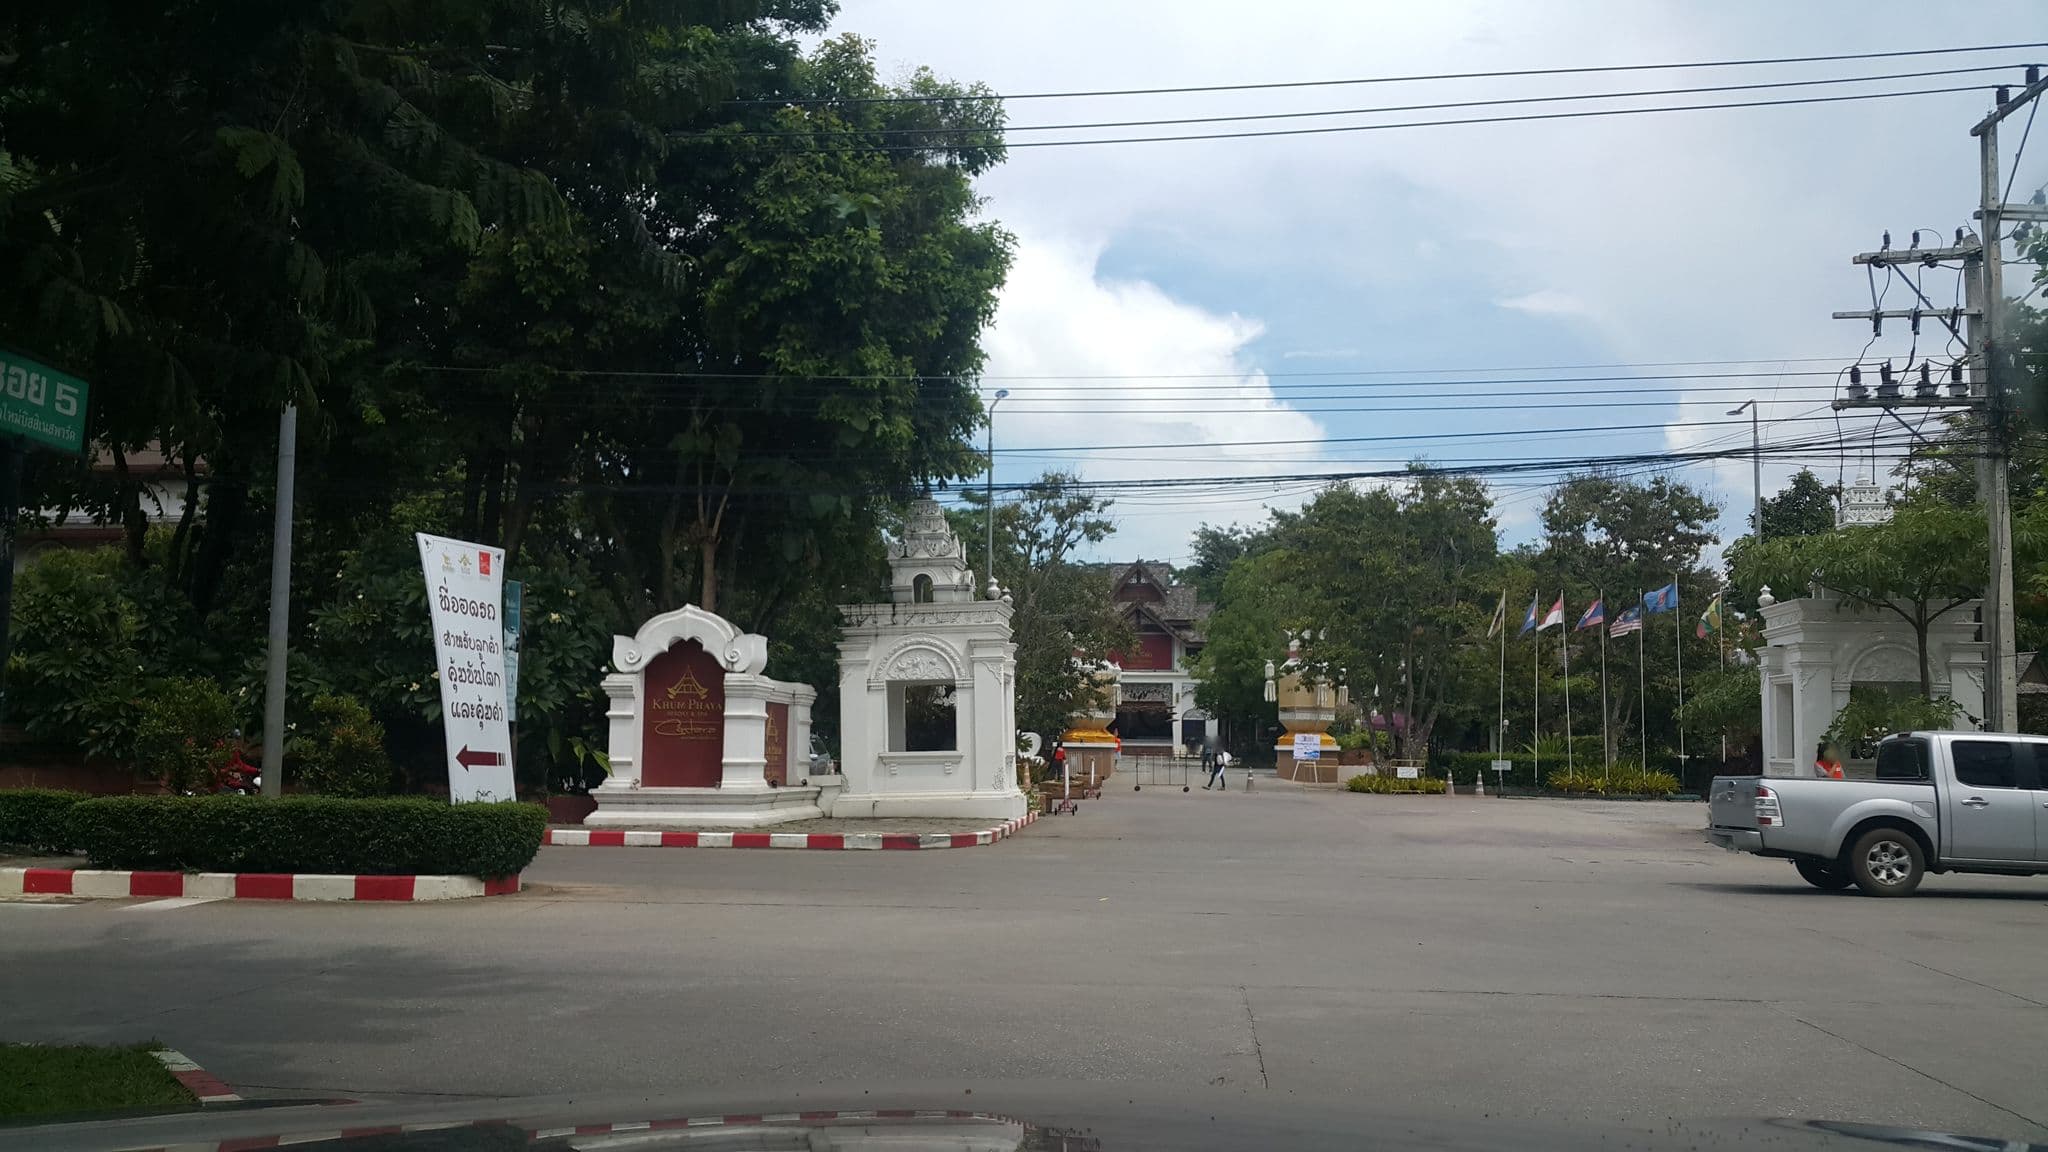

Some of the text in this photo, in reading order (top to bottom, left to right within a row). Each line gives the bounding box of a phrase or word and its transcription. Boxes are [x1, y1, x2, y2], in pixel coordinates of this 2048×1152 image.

[54, 382, 80, 417] 5
[439, 576, 496, 621] ที่จอดรถ
[443, 630, 499, 661] สำหรับลูกค้า
[448, 656, 501, 694] คุ้มขันโตก
[451, 694, 504, 731] และคุ้มคำ
